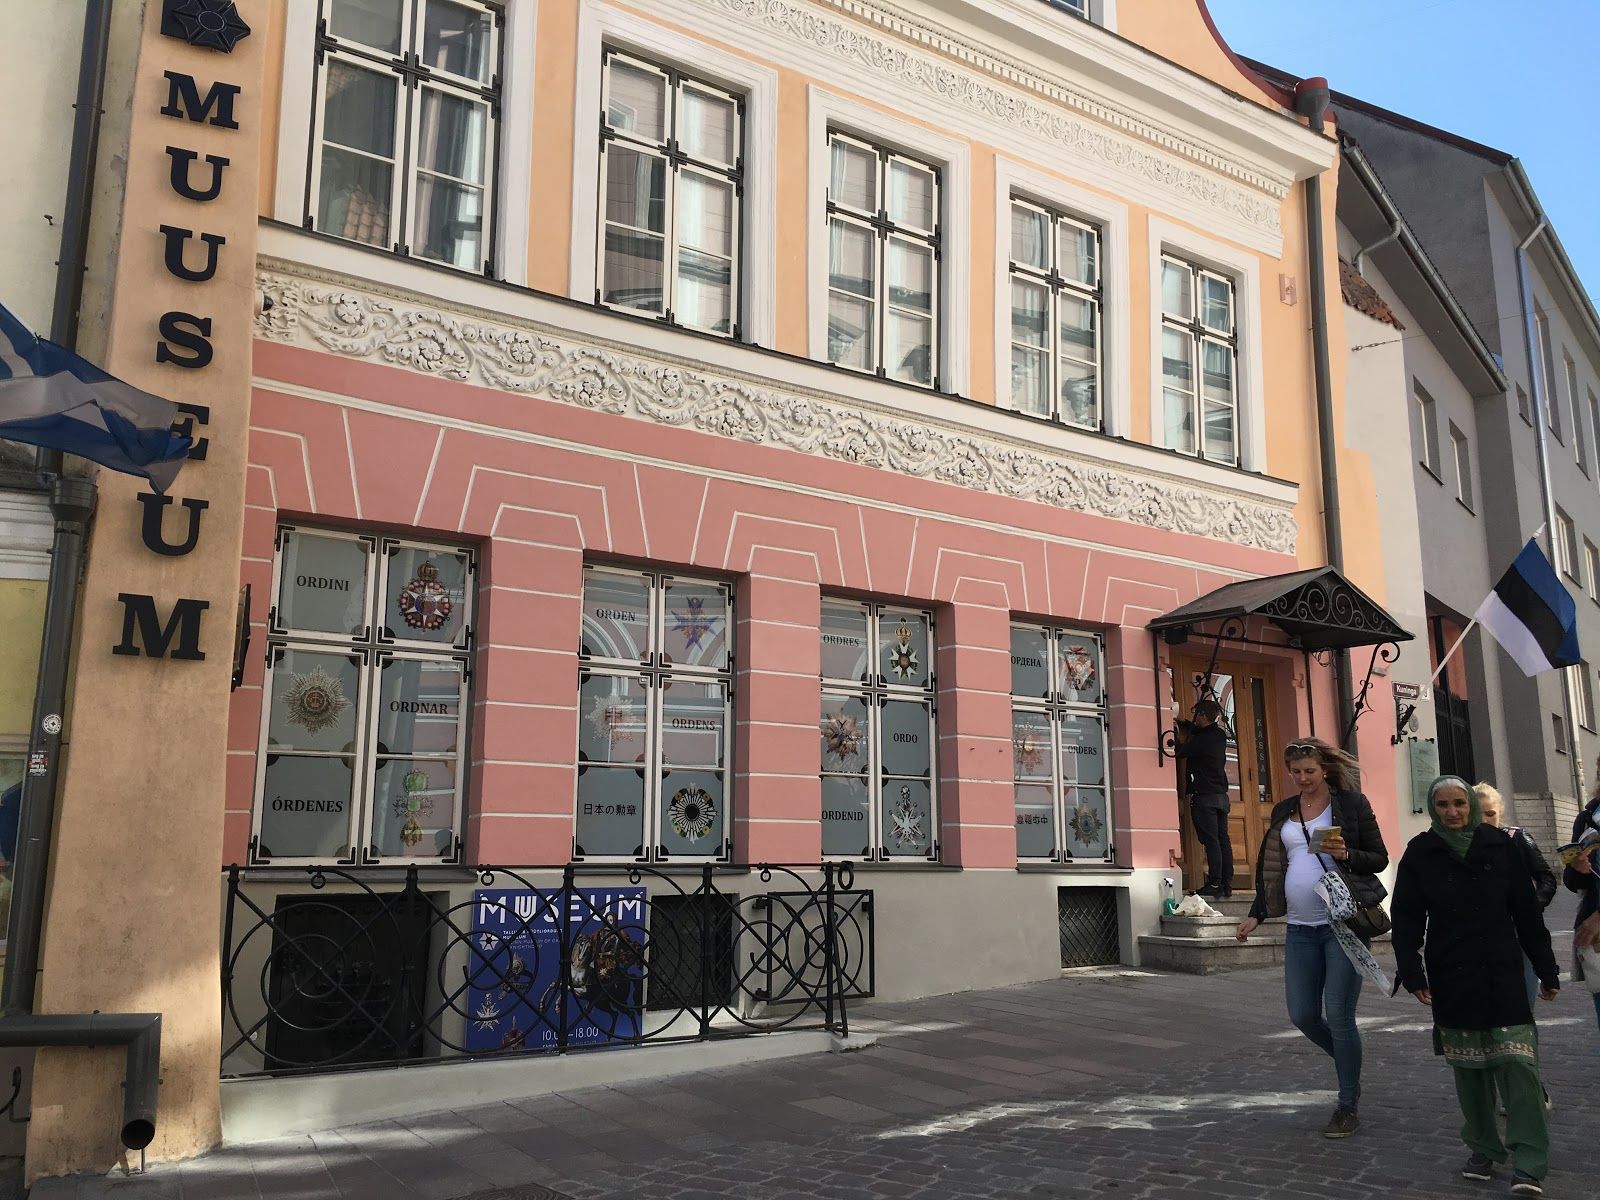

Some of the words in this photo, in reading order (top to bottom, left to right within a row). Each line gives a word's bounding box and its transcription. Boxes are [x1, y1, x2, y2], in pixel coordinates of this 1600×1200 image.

[112, 70, 241, 661] MUUSEUM
[296, 575, 350, 592] ORDINI
[596, 608, 636, 622] ORDEN
[823, 634, 860, 647] ORDRES
[1010, 655, 1042, 668] ОРДЕНА
[390, 700, 449, 715] ORDNAR
[672, 718, 716, 731] ORDENS
[893, 732, 918, 744] ORDO
[1067, 745, 1097, 756] ORDERS
[1256, 719, 1266, 773] KASSA
[272, 796, 344, 813] ÓRDENES
[821, 810, 864, 821] ORDENID
[479, 892, 644, 925] MUSEUM
